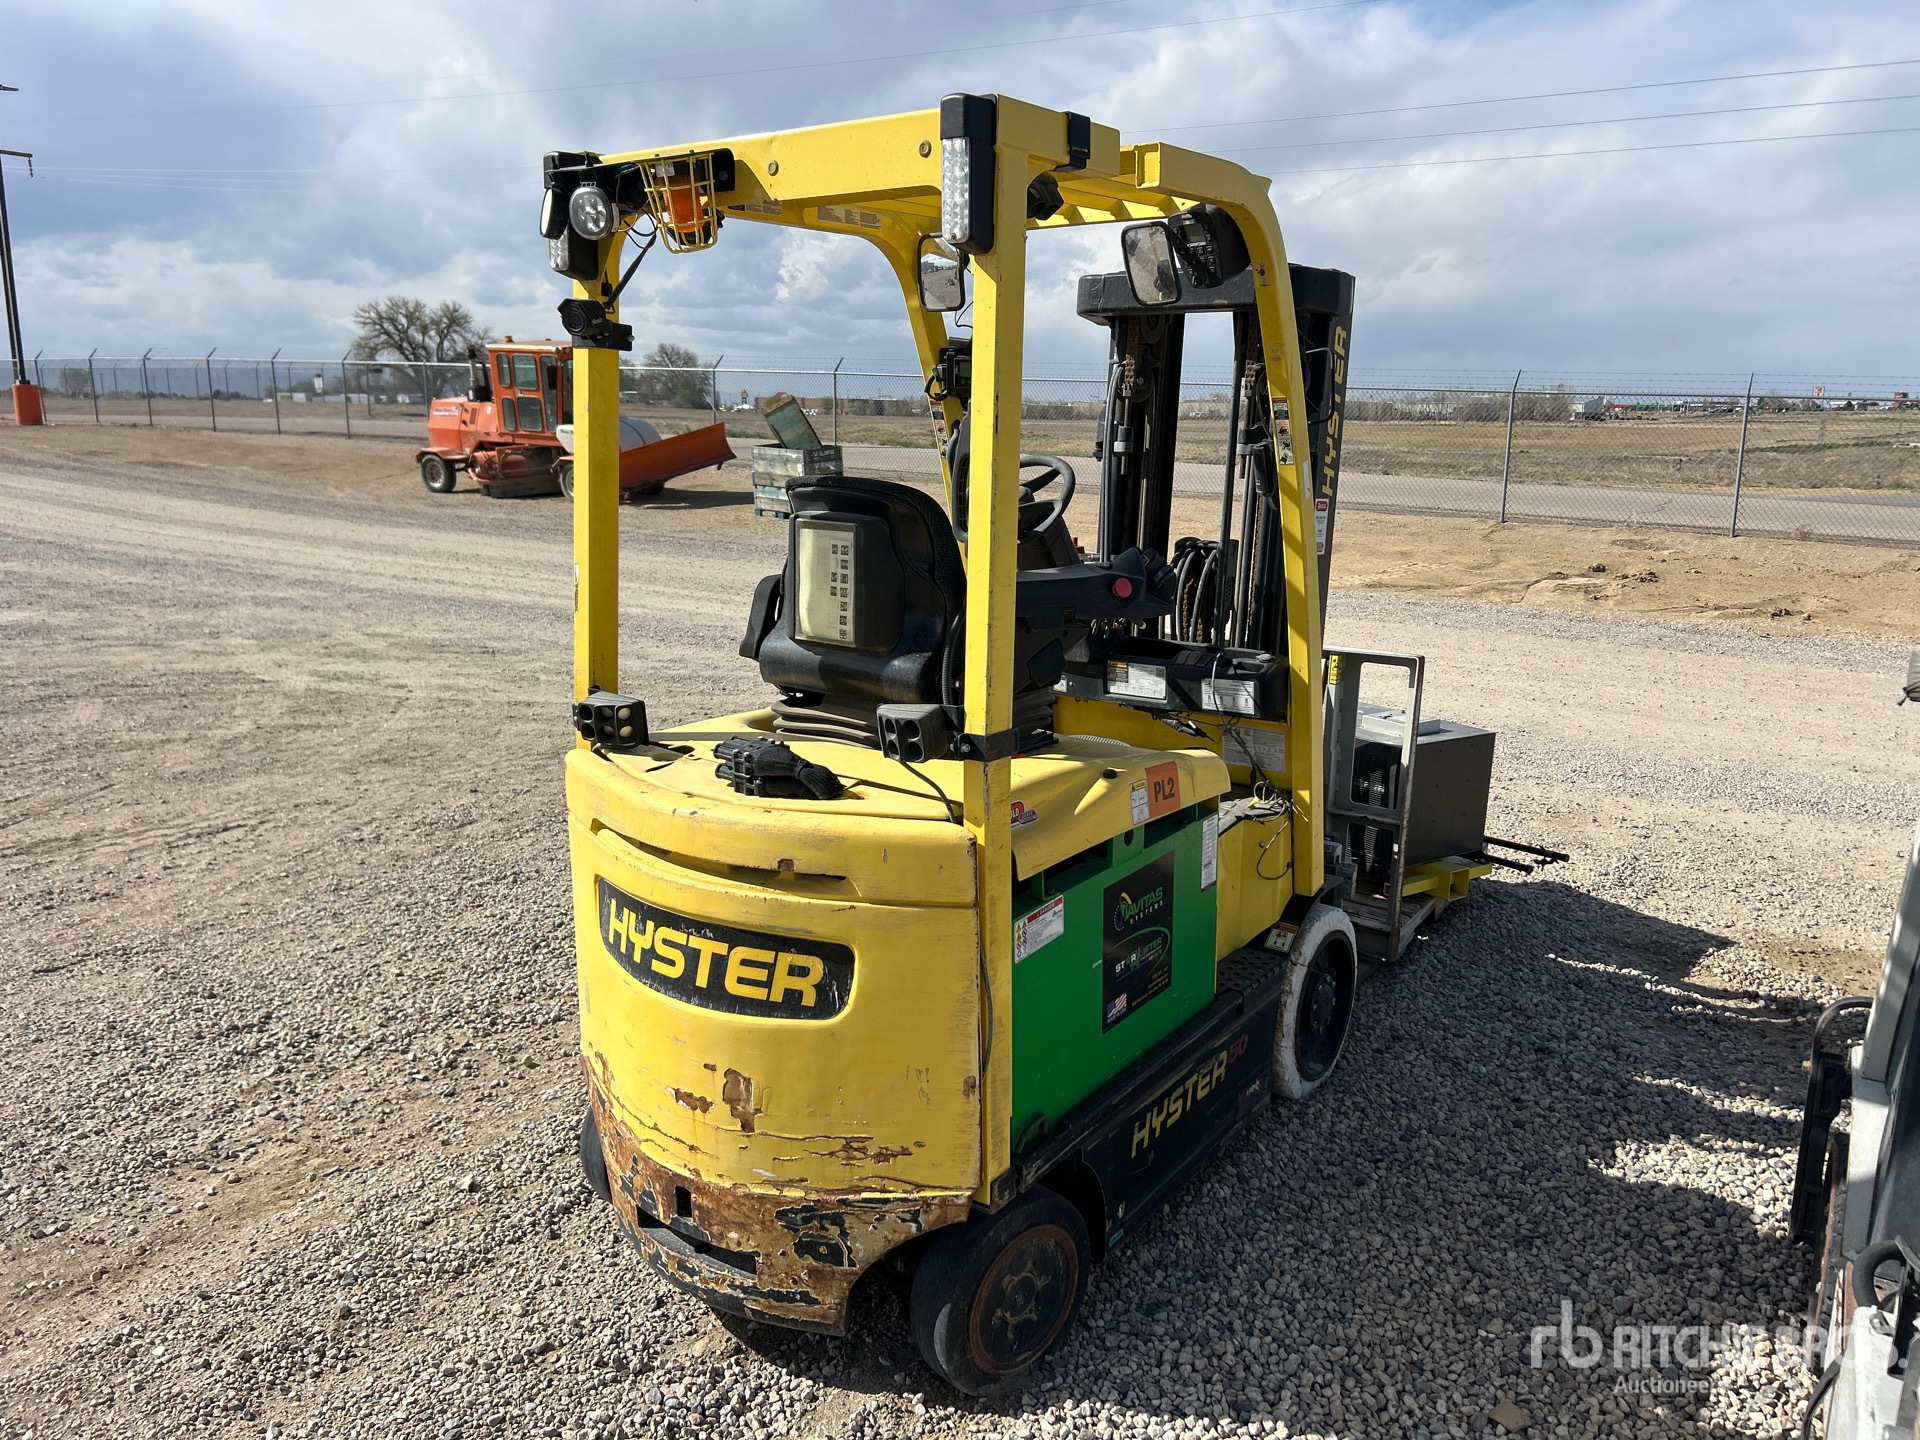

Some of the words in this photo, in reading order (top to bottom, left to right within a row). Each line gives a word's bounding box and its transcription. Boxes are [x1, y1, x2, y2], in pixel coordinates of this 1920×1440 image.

[1154, 777, 1176, 803] PL2
[1130, 900, 1163, 925] SYSTEMS
[608, 898, 824, 1007] HYSTER
[1131, 1050, 1228, 1159] HYSTER
